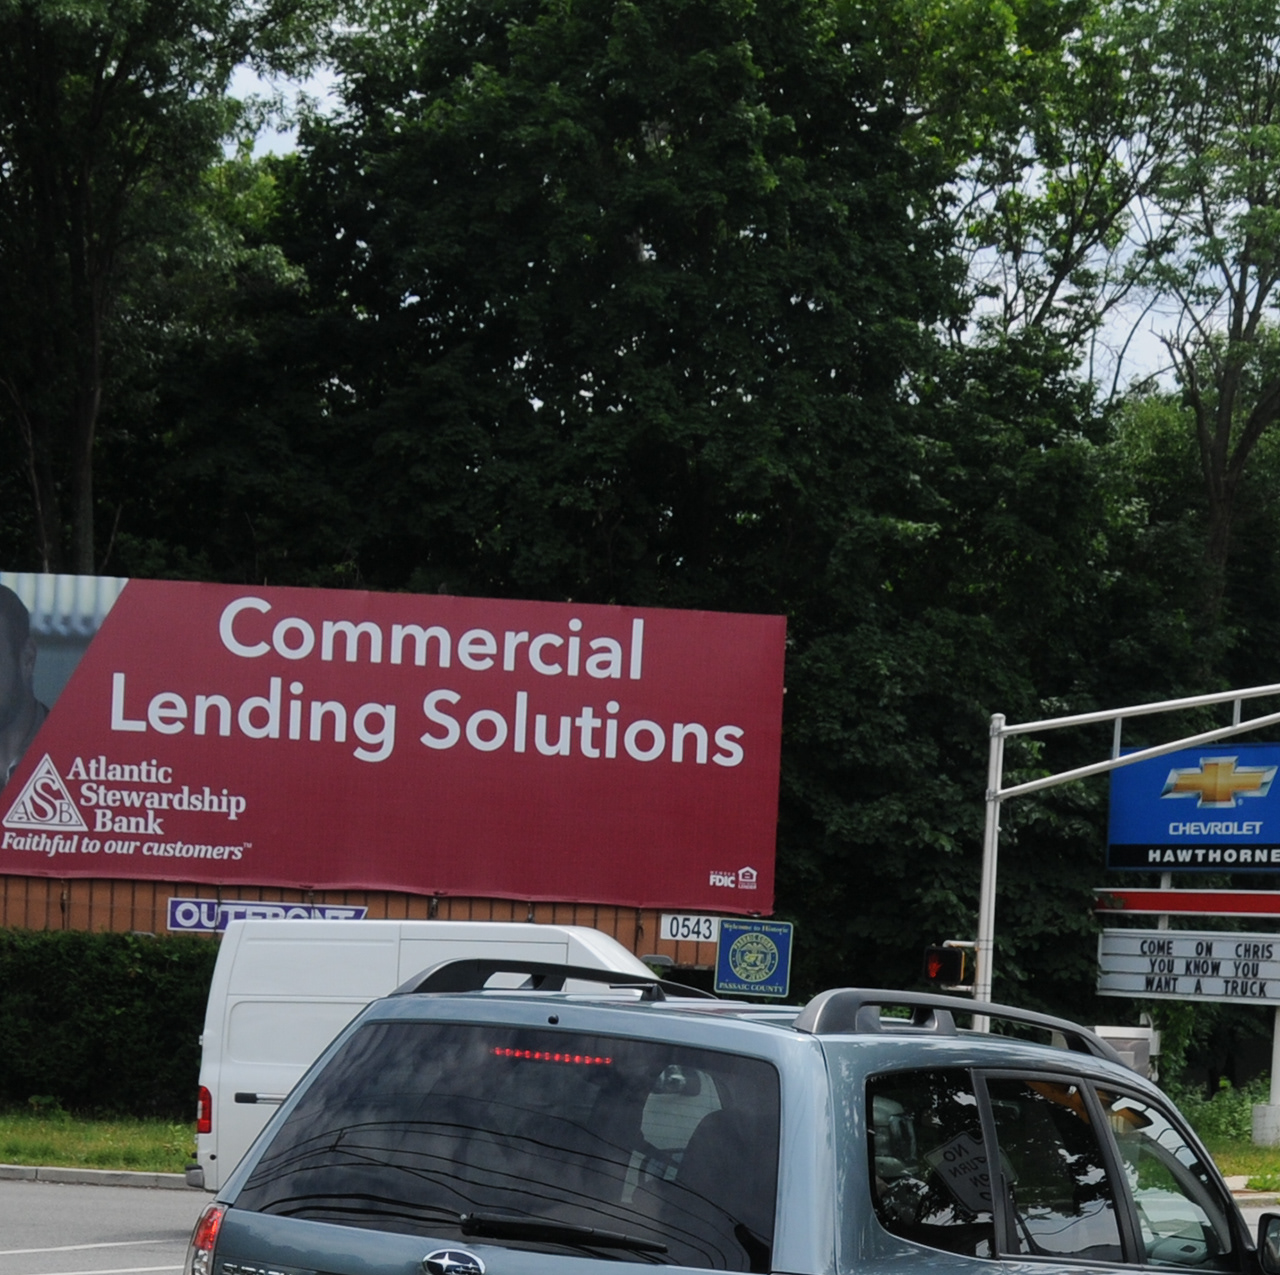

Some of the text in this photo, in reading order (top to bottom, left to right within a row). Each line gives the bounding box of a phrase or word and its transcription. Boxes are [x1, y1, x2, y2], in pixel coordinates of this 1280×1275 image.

[219, 596, 644, 680] Commercial
[110, 672, 746, 767] Lending Solutions
[66, 755, 173, 784] Atlantic
[80, 782, 247, 820] Stewardship
[93, 809, 165, 835] Bank
[1169, 821, 1263, 835] CHEVROLET
[1, 831, 80, 858] Faithful
[81, 836, 101, 854] to
[103, 839, 141, 855] our
[709, 875, 736, 888] FDIC
[670, 916, 713, 940] 0543
[1140, 940, 1273, 959] COME ON CHRIS
[1149, 957, 1259, 978] YOU KNOW YOU
[719, 981, 784, 993] PASSAIC COUNTY
[1145, 976, 1267, 997] WANT A TRUCK
